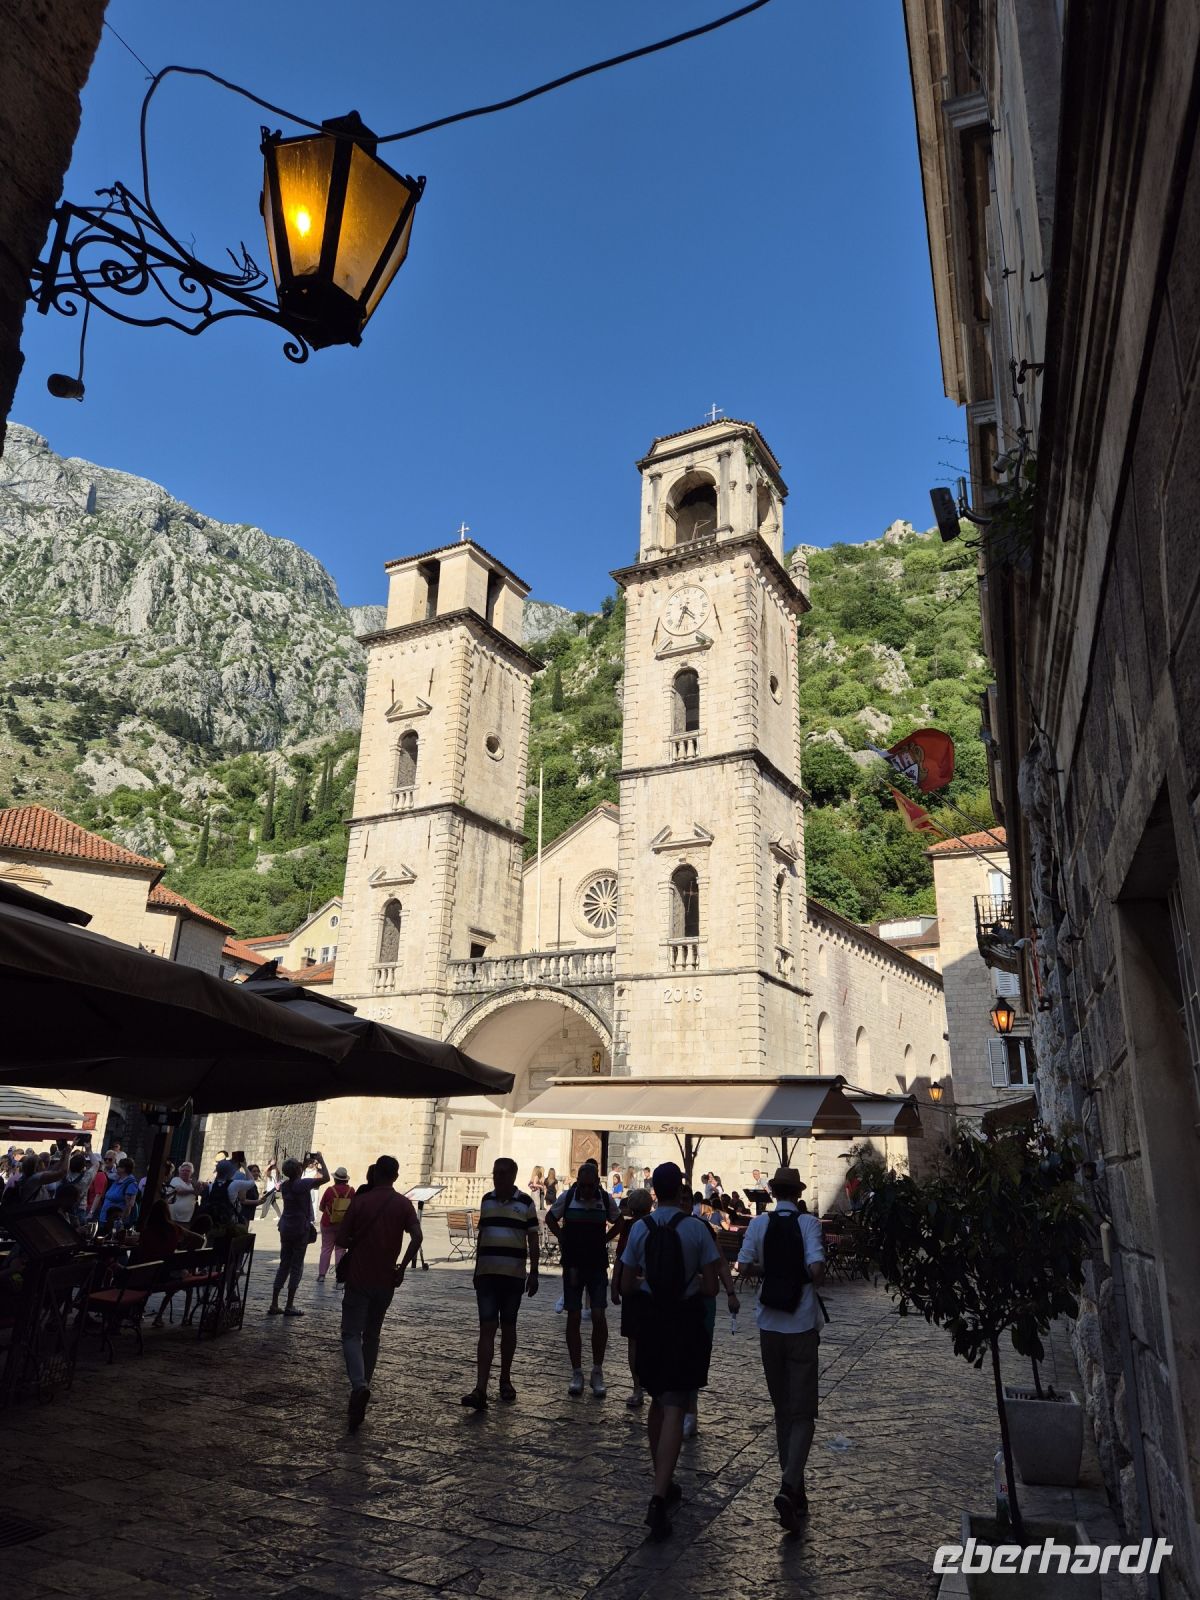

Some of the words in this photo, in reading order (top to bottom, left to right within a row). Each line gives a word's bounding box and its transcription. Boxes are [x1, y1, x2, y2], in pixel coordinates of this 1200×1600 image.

[663, 987, 703, 1003] 2016
[618, 1123, 651, 1131] PIZZERIA
[659, 1123, 685, 1133] Sara
